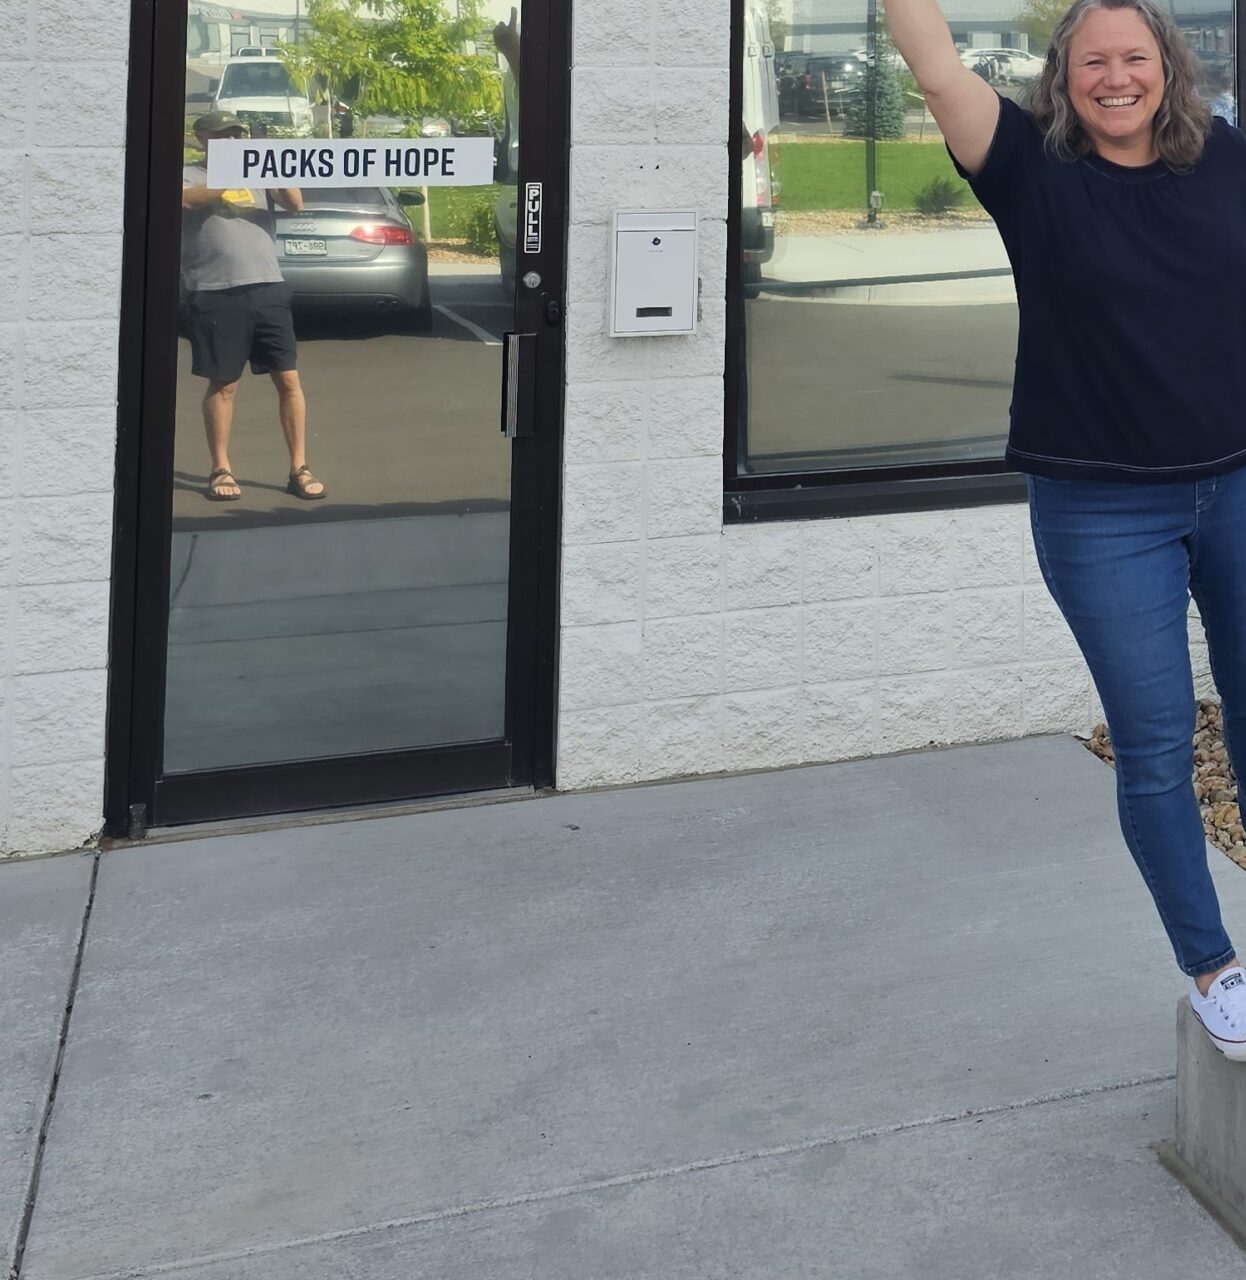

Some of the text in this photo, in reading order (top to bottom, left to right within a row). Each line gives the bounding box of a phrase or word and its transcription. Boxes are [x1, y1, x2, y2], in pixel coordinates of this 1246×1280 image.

[242, 147, 455, 178] PACKS OF HOPE
[527, 188, 540, 236] PULL
